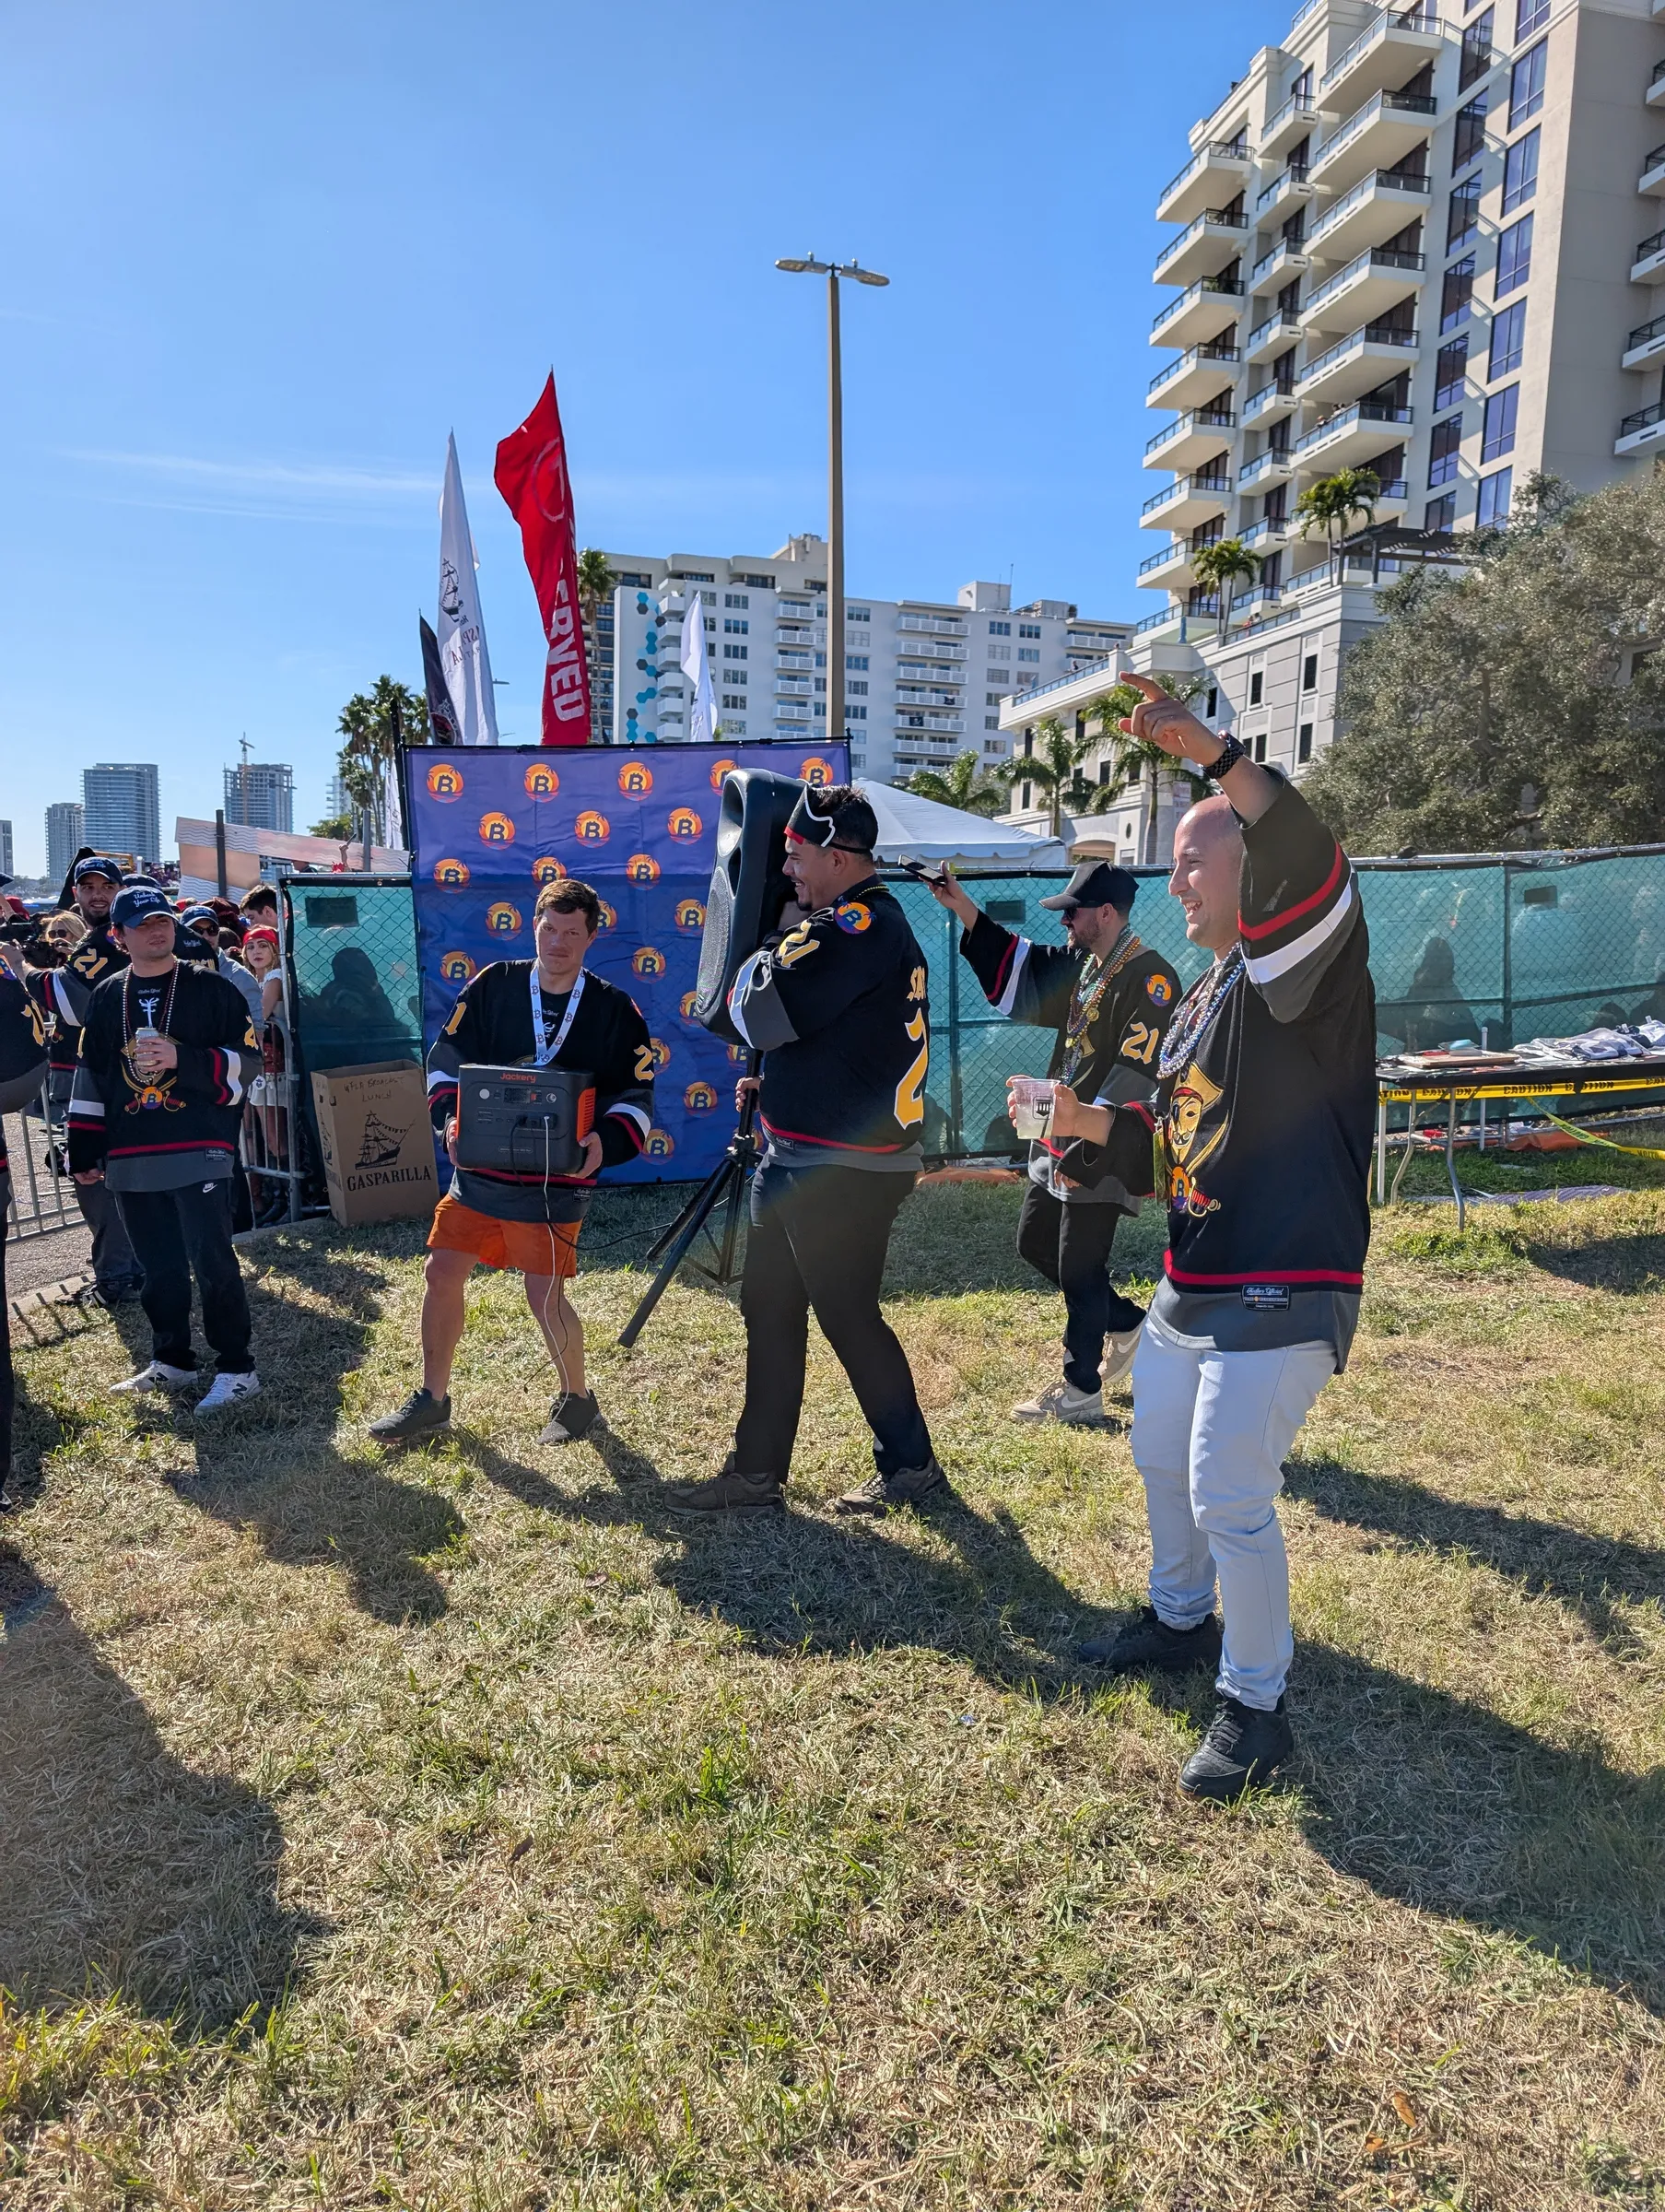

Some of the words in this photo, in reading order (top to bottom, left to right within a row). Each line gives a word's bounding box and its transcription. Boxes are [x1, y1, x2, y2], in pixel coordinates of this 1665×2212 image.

[74, 947, 108, 979] 21
[1121, 1022, 1160, 1065] 21
[634, 1044, 655, 1081] 2
[500, 1073, 536, 1083] Jackery
[1504, 1084, 1553, 1095] CAUTION
[346, 1165, 432, 1192] GASPARILLA
